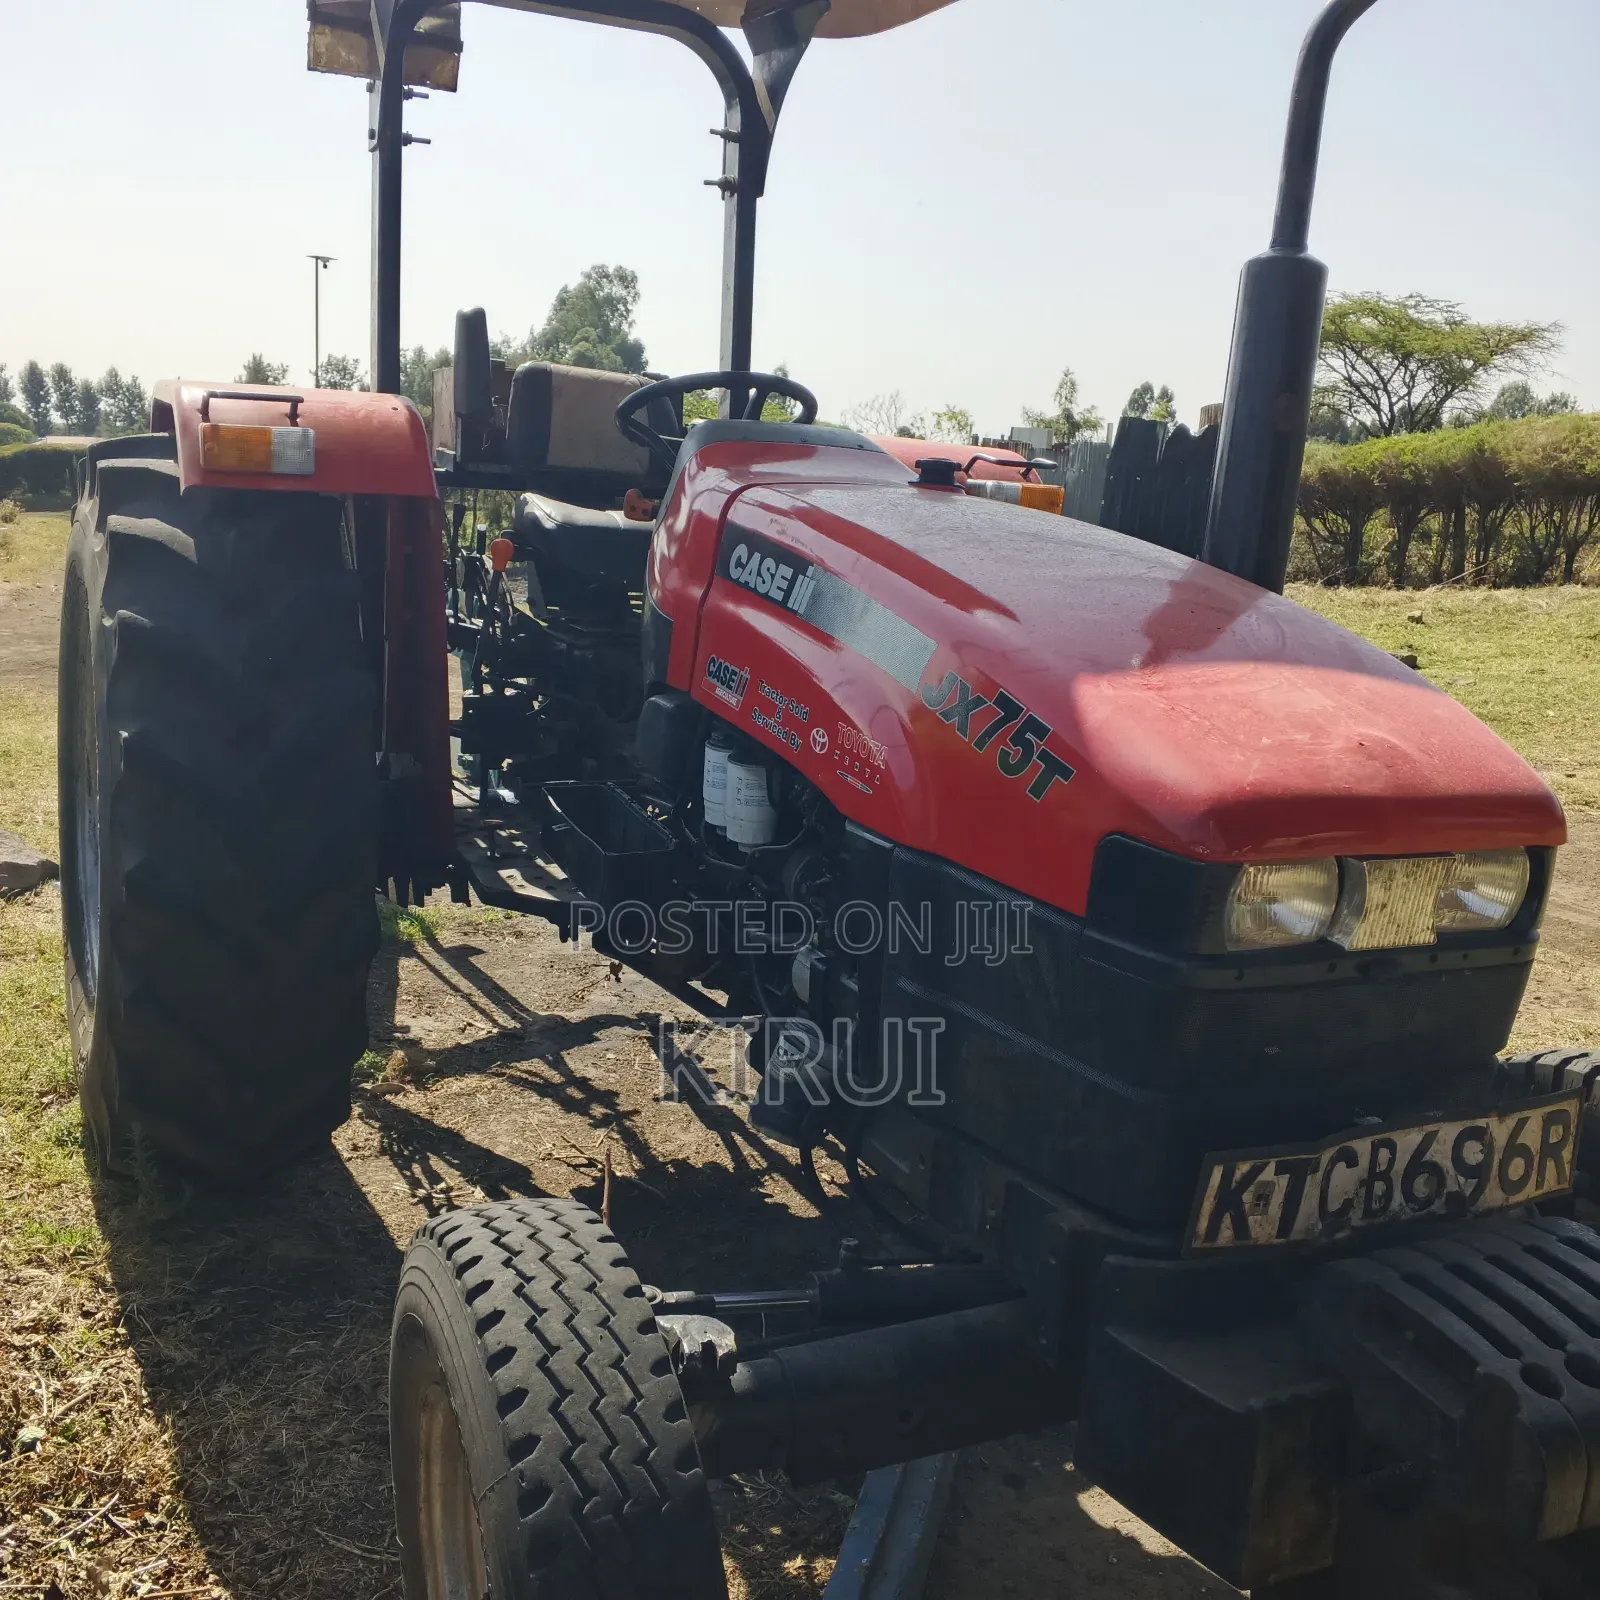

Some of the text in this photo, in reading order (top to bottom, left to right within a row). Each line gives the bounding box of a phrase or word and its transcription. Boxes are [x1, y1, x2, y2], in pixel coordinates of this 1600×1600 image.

[729, 543, 794, 602] CASE
[706, 654, 739, 692] CASE
[758, 679, 810, 723] Tractor Sold
[774, 706, 783, 722] &
[751, 707, 803, 753] Serviced By
[837, 721, 889, 770] TOYOTA
[920, 669, 1076, 803] JX75T
[1203, 1108, 1573, 1243] KTCB696R
